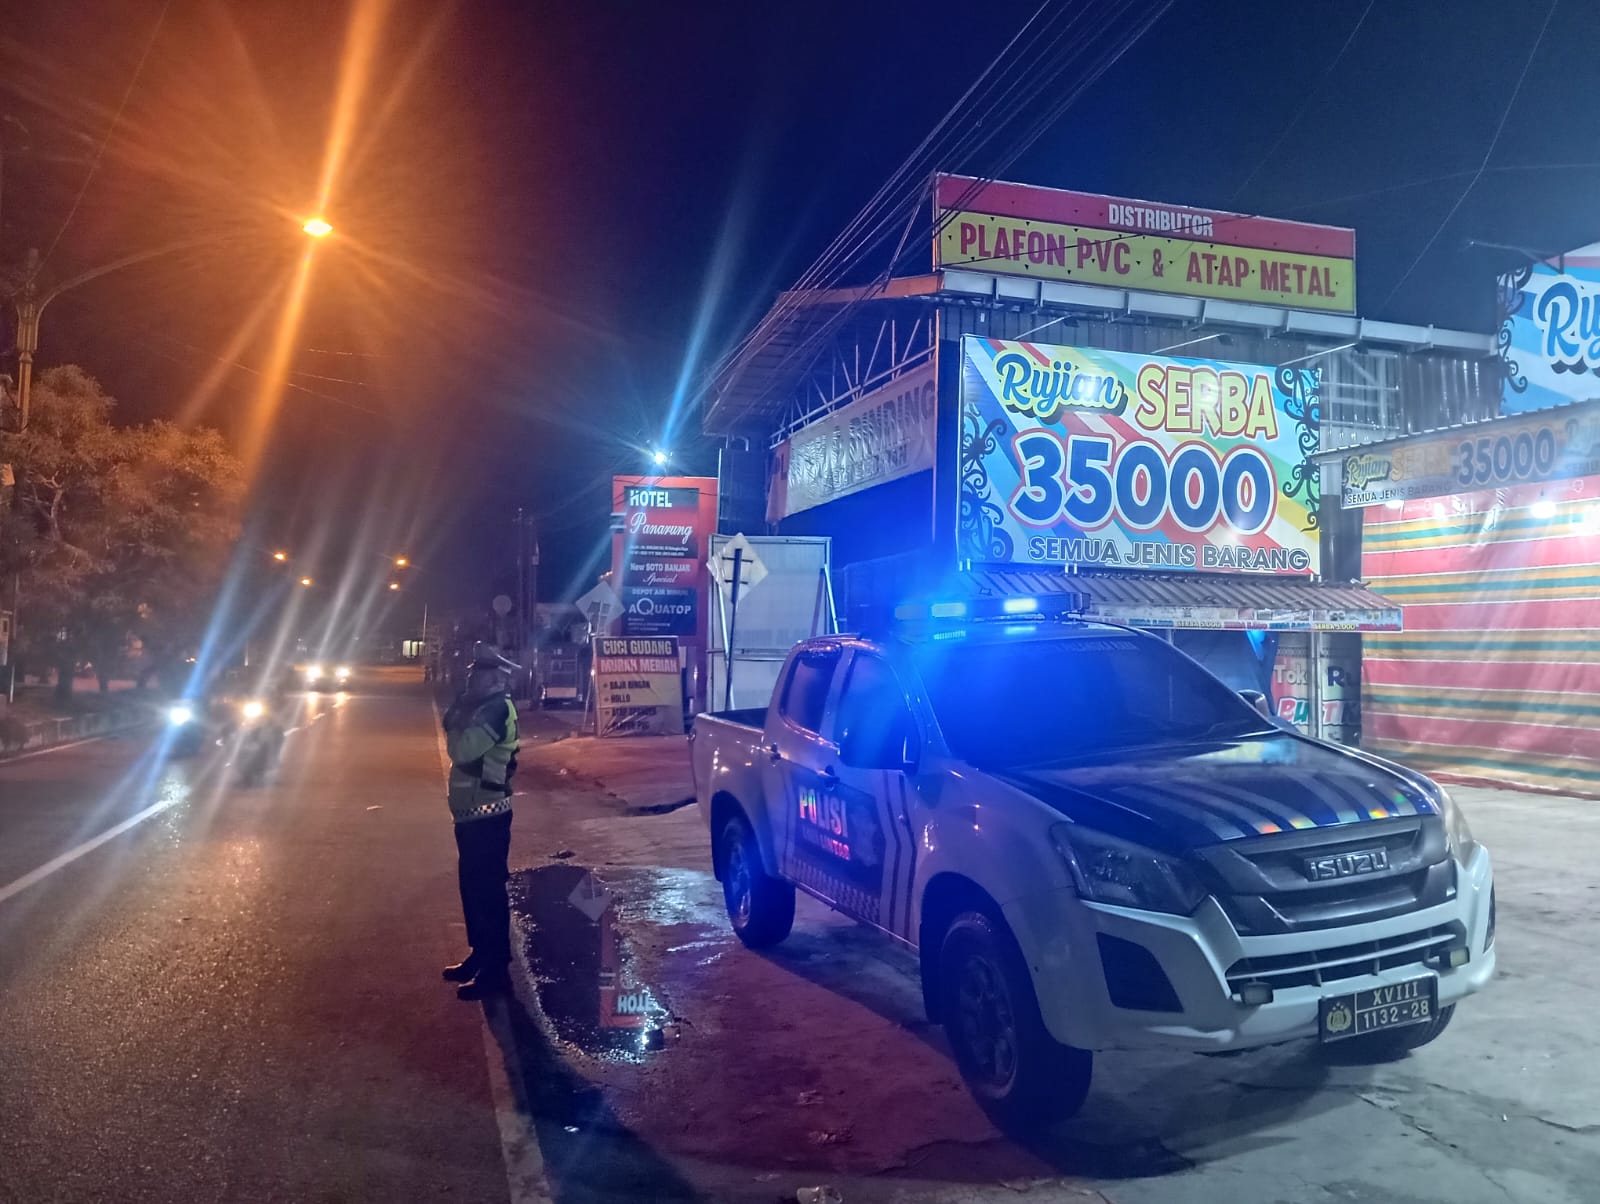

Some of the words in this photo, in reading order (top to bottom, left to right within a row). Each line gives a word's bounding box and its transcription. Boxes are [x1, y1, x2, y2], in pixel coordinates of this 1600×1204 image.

[1108, 203, 1214, 238] DISTRIBUTOR
[960, 222, 1066, 267] PLAFON
[1076, 237, 1131, 275] PVC
[1151, 247, 1164, 278] &
[1186, 252, 1250, 288] ATAP
[1260, 260, 1337, 298] METAL
[1538, 281, 1600, 360] Ru
[996, 352, 1120, 412] Rujian
[1136, 364, 1280, 441] SERBA
[1457, 427, 1556, 486] 35000
[629, 489, 673, 508] HOTEL
[1012, 432, 1275, 535] 35000
[1347, 492, 1378, 504] SEMUA
[1379, 486, 1406, 501] JENIS
[629, 511, 694, 545] Panarung
[1029, 536, 1120, 564] SEMUA
[1126, 543, 1196, 568] JENIS
[1202, 546, 1311, 571] BARANG
[629, 597, 692, 616] AQUATOP
[603, 640, 628, 655] CUCI
[630, 640, 673, 655] GUDANG
[798, 784, 849, 839] POLISI
[1310, 850, 1391, 880] ISUZU
[1373, 982, 1419, 1006] XVIII
